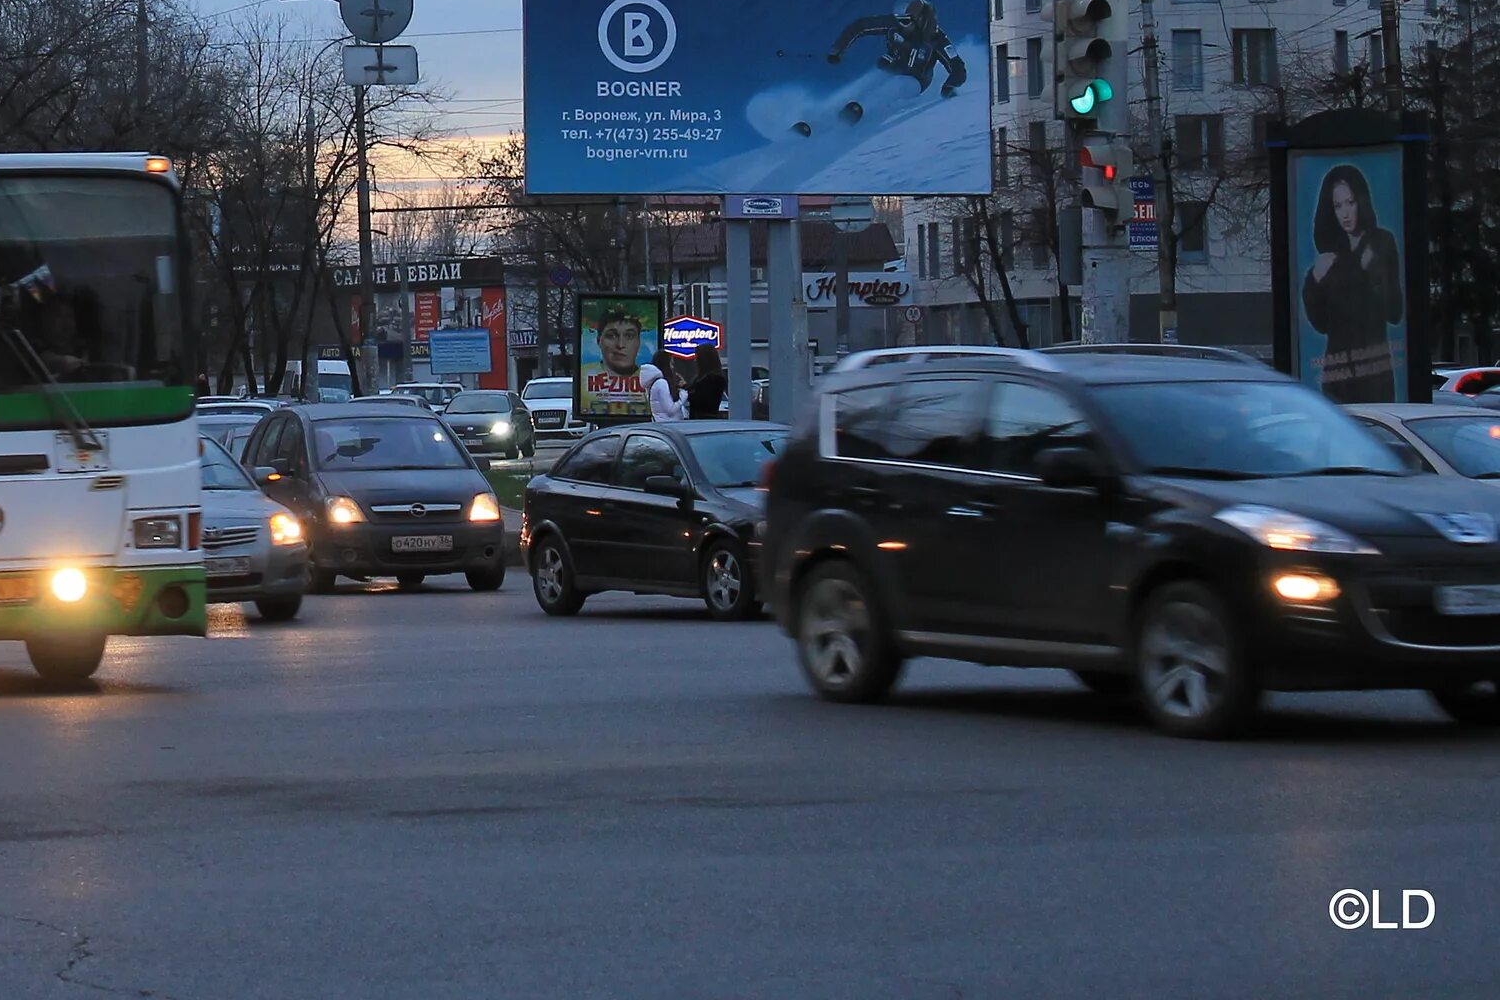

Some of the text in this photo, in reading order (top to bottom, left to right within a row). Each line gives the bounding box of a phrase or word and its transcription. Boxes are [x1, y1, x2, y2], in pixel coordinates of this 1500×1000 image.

[597, 81, 682, 97] BOGNER
[562, 109, 722, 123] г. Воронеж, ул. Мира, 3
[561, 128, 722, 143] тел. +7(473) 255-49-27
[586, 146, 688, 161] bogner-vrn.ru
[333, 267, 387, 286] САЛН
[807, 276, 909, 300] Hmpton
[663, 327, 717, 342] Hampton
